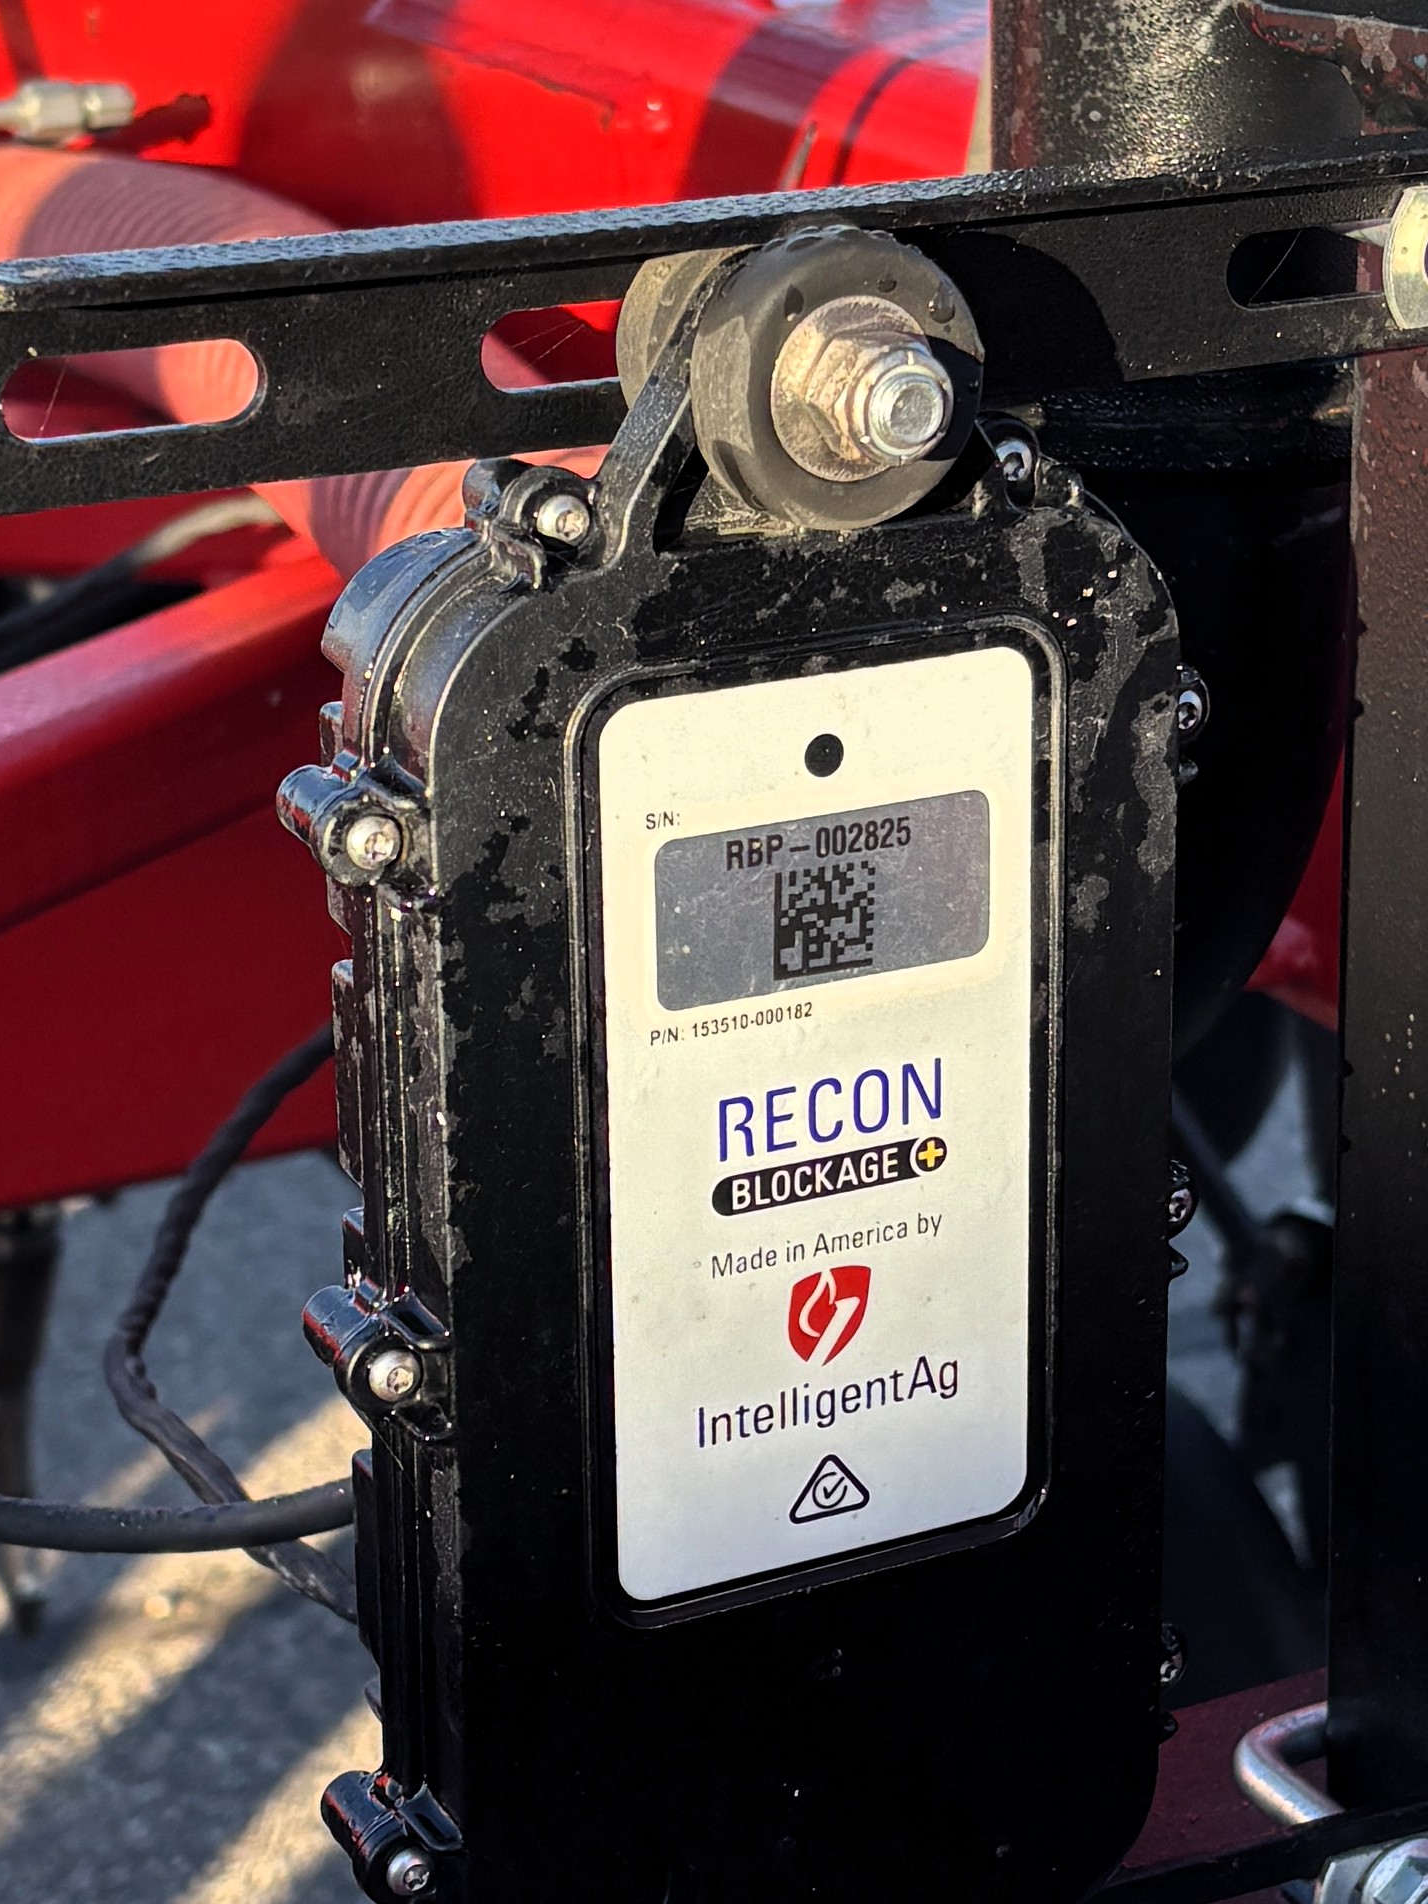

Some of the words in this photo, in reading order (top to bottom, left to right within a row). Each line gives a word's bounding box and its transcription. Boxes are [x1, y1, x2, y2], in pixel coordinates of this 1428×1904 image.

[645, 810, 681, 830] S/N:
[725, 816, 912, 872] RBP-002825
[650, 1026, 685, 1047] P/N:
[718, 1057, 942, 1162] RECON
[731, 1147, 899, 1211] BLOCKAGE
[711, 1246, 778, 1279] Made
[786, 1240, 805, 1263] in
[812, 1220, 908, 1259] America
[917, 1211, 943, 1238] by
[698, 1355, 959, 1448] IntelligentAg
